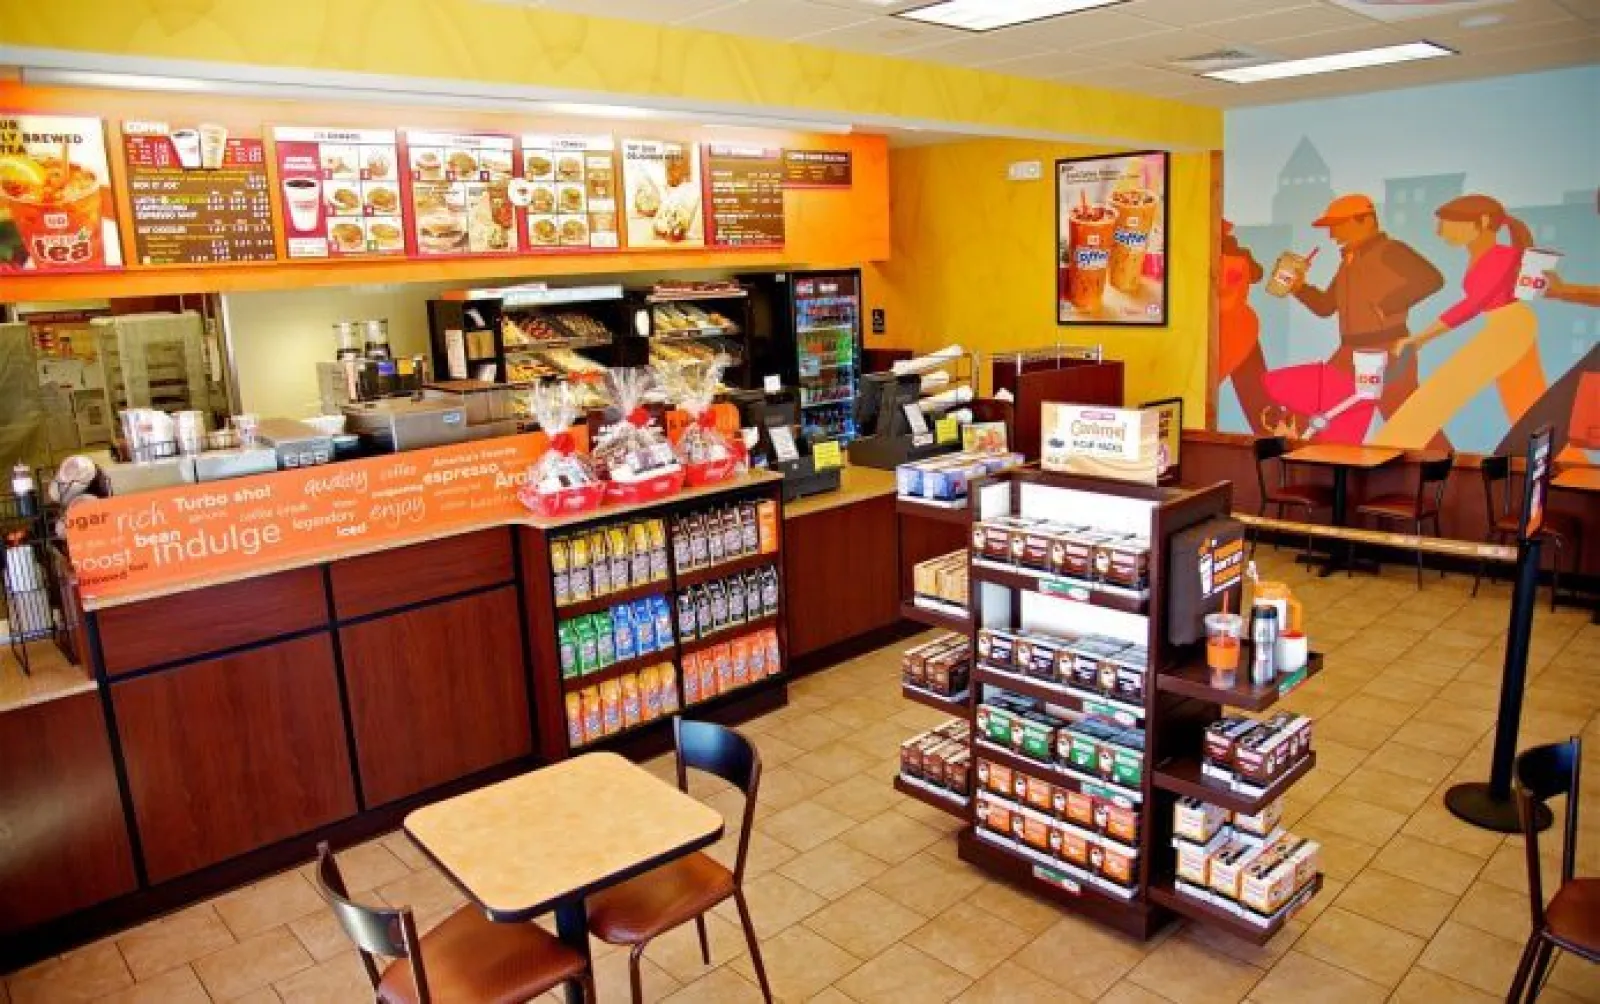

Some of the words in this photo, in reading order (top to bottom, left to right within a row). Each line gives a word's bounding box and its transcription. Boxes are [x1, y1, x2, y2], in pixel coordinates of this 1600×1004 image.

[22, 132, 83, 144] BREWED
[34, 238, 89, 262] tea
[304, 466, 368, 497] quality
[422, 463, 499, 486] espresso
[173, 493, 228, 512] Turbo
[232, 485, 271, 504] shot
[116, 500, 165, 535] rich
[292, 510, 356, 532] legendary
[369, 495, 425, 530] enjoy
[134, 530, 181, 547] bean
[153, 522, 281, 567] indulge
